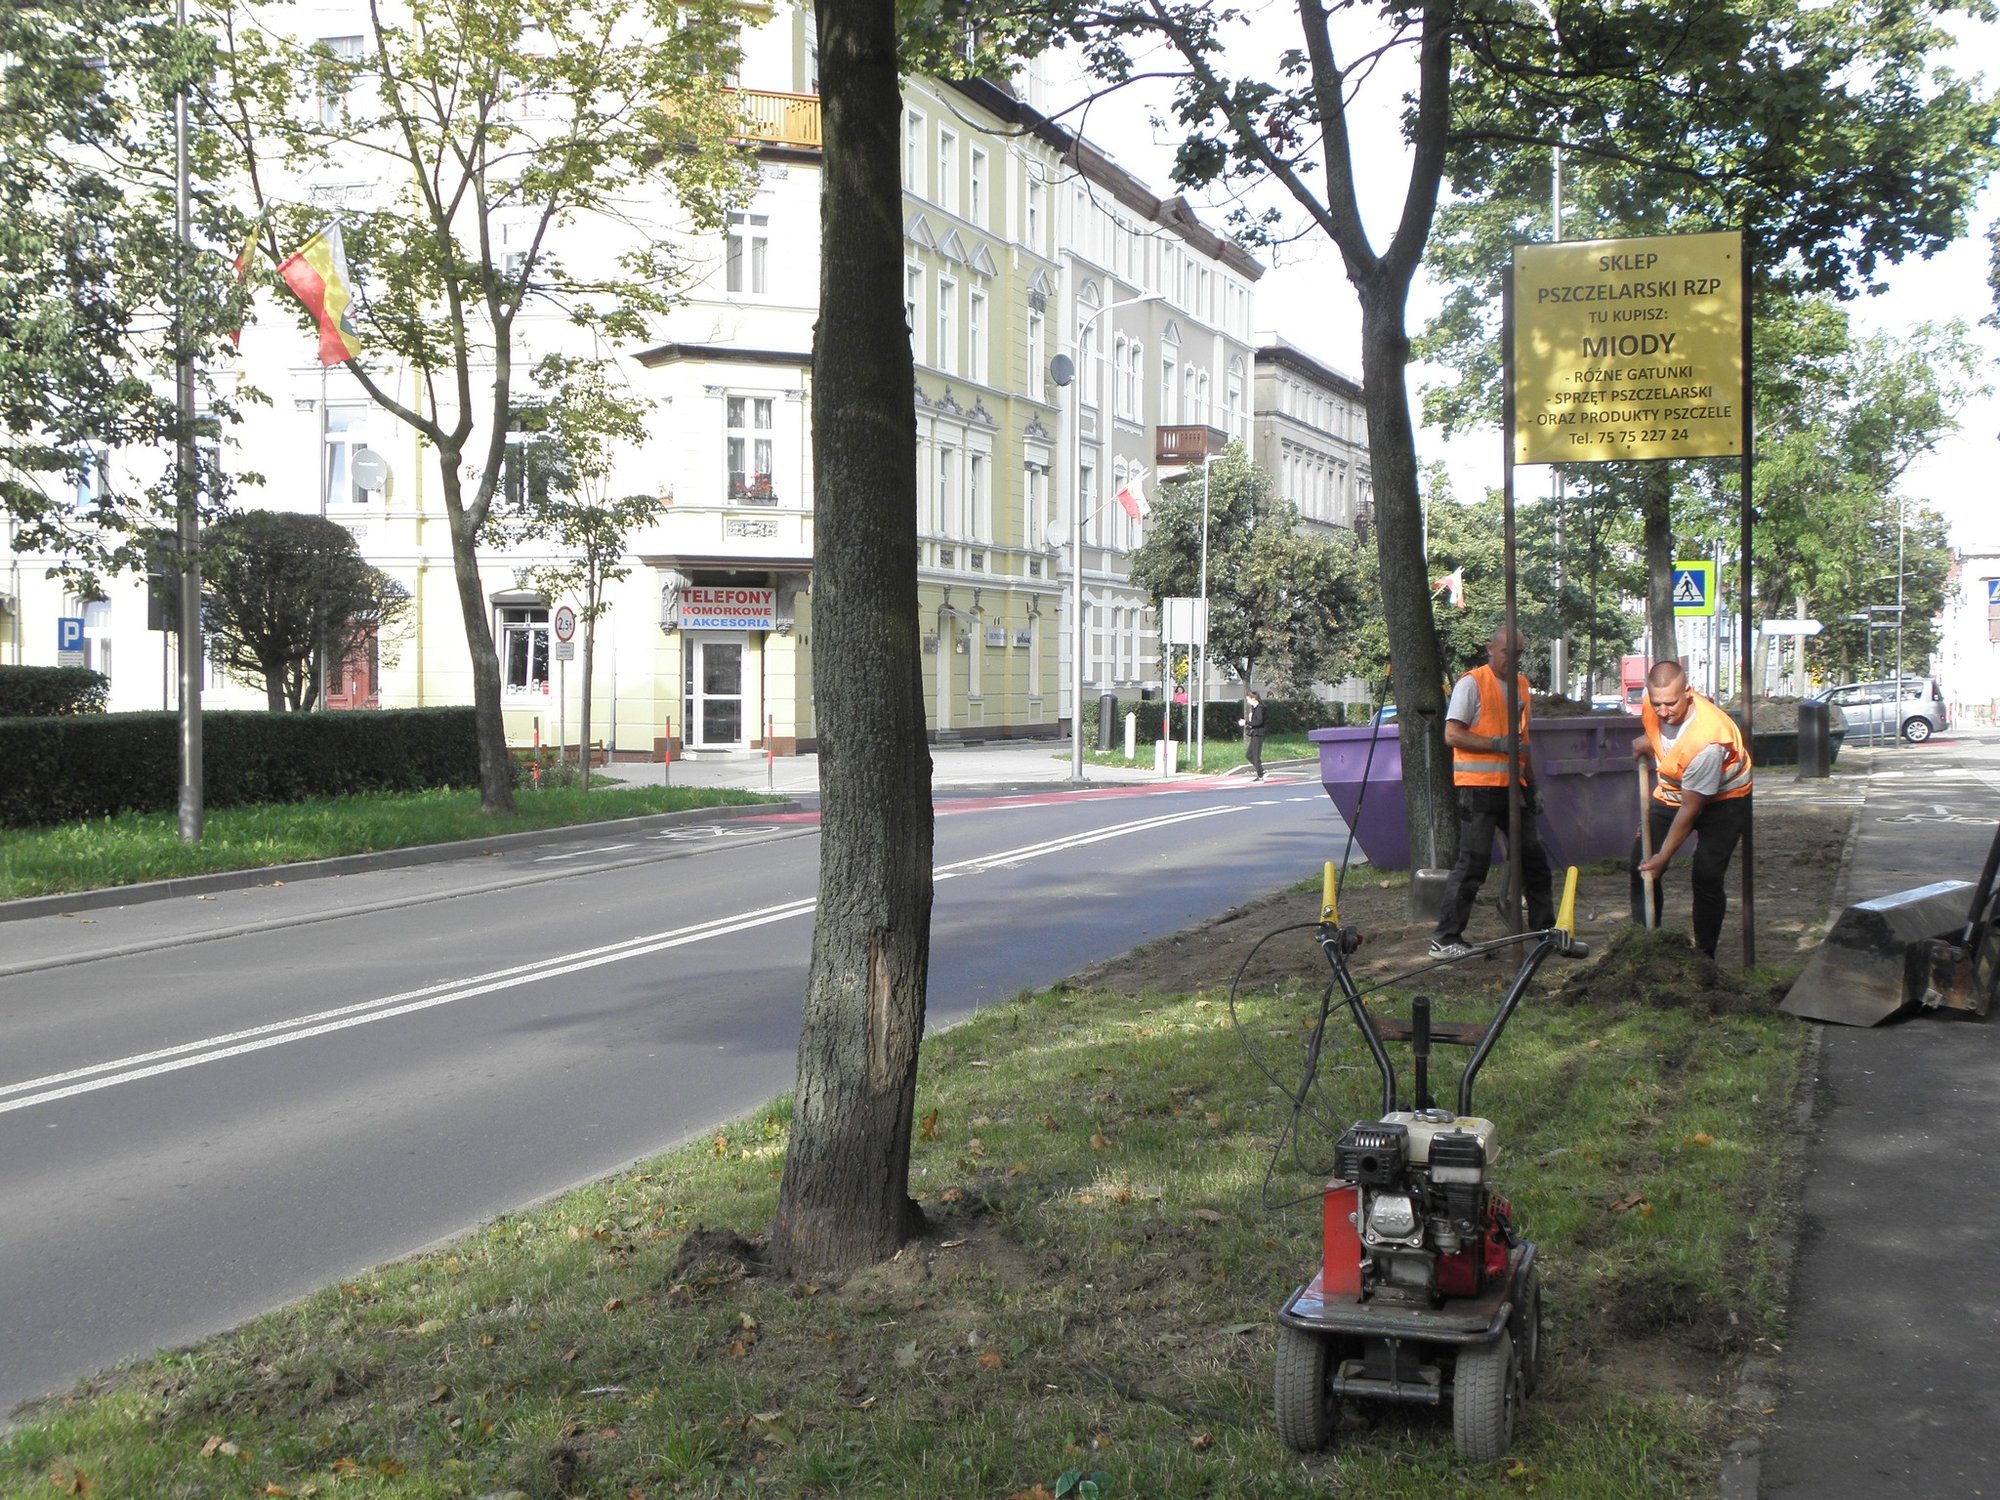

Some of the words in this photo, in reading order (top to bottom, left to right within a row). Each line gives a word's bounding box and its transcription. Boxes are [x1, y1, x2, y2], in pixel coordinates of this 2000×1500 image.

[1599, 253, 1658, 272] SKLEP
[1538, 281, 1677, 304] PSZCZELARSKI
[1684, 278, 1721, 295] RZP
[1589, 311, 1607, 323] TU
[1613, 308, 1668, 322] KUPISZ:
[1583, 333, 1676, 358] MIODY
[1574, 367, 1622, 383] RÓŻNE
[1628, 366, 1693, 380] GATUNKI
[1555, 391, 1606, 406] SPRZĘT
[1611, 386, 1712, 402] PSZCZELARSKI
[1537, 412, 1576, 426] ORAZ
[1581, 409, 1659, 423] PRODUKTY
[1664, 406, 1732, 420] PSZCZELE
[1570, 432, 1593, 445] Tel.
[1598, 431, 1614, 444] 75
[1619, 431, 1636, 443] 75
[1641, 429, 1666, 442] 227
[1671, 428, 1688, 441] 24
[681, 590, 773, 604] TELEFONY
[682, 605, 772, 616] KOMÓRKOWE
[683, 618, 687, 626] I
[692, 618, 770, 627] AKCESORIA
[64, 621, 79, 647] P
